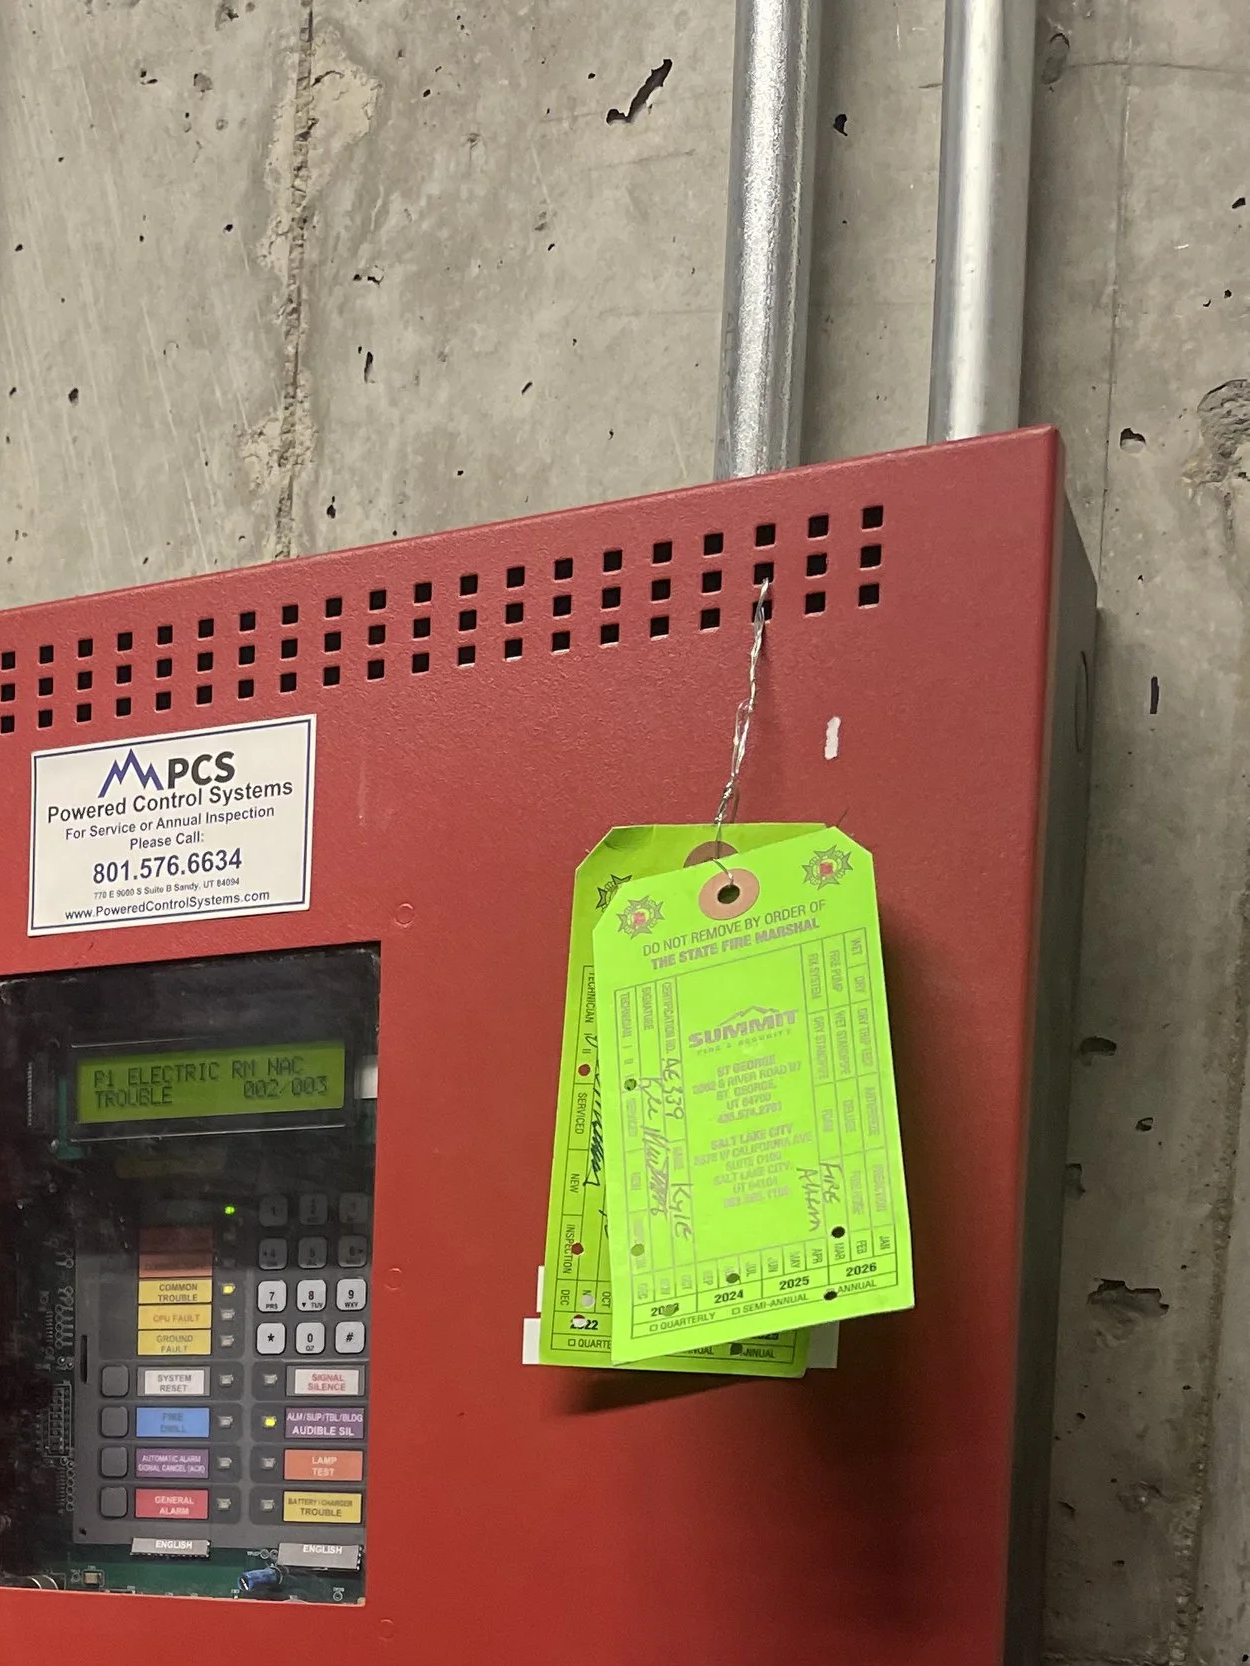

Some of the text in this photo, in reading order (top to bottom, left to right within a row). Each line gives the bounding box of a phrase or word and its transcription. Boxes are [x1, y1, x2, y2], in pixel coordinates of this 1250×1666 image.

[167, 750, 236, 790] PCS
[47, 780, 294, 824] Powered Control Systems
[65, 805, 275, 841] For Service or Annual Inspection
[129, 831, 205, 851] Please Call:
[92, 847, 243, 885] 801.576.6634
[108, 891, 115, 899] E
[136, 887, 142, 896] S
[144, 886, 164, 896] Suite
[165, 884, 172, 893] B
[203, 880, 215, 889] UT
[65, 890, 270, 920] www.PoweredControlSystems.com
[643, 899, 827, 958] DO NOT REMOVE BY ORDER OF
[651, 917, 820, 971] THE STATE FIRE MARSHAL
[688, 1009, 799, 1049] SUMMIT
[93, 1056, 304, 1089] P1 ELECTRIC RM NAC
[93, 1086, 174, 1109] TROUBLE
[572, 1092, 587, 1136] SERVICED
[570, 1173, 581, 1194] NEW
[856, 1239, 868, 1254] FEB
[879, 1235, 890, 1250] JAN
[812, 1248, 823, 1265] APR
[159, 1283, 198, 1292] COMMON
[714, 1262, 877, 1305] 2024 2025 2026
[158, 1294, 198, 1302] TROUBLE
[269, 1291, 275, 1301] 7
[308, 1290, 314, 1301] 8
[348, 1289, 354, 1299] 9
[560, 1288, 571, 1307] DEC
[660, 1279, 877, 1331] QUARTERLY SEMI-ANNUAL ANNUAL
[172, 1314, 200, 1322] FAULT
[156, 1334, 193, 1344] GROUND
[307, 1333, 313, 1343] 0
[161, 1345, 189, 1353] FAULT
[157, 1374, 192, 1383] SYSTEM
[312, 1373, 344, 1382] SIGNAL
[160, 1384, 188, 1392] RESET
[307, 1382, 346, 1391] SILENCE
[292, 1426, 355, 1437] AUDIBLE SIL
[142, 1454, 179, 1463] AUTOMATIC
[312, 1456, 338, 1465] LAMP
[312, 1467, 335, 1476] TEST
[155, 1495, 195, 1505] GENERAL
[159, 1506, 190, 1515] ALARM
[300, 1507, 342, 1517] TROUBLE
[155, 1540, 193, 1549] ENGLISH
[303, 1544, 343, 1554] ENGLISH
